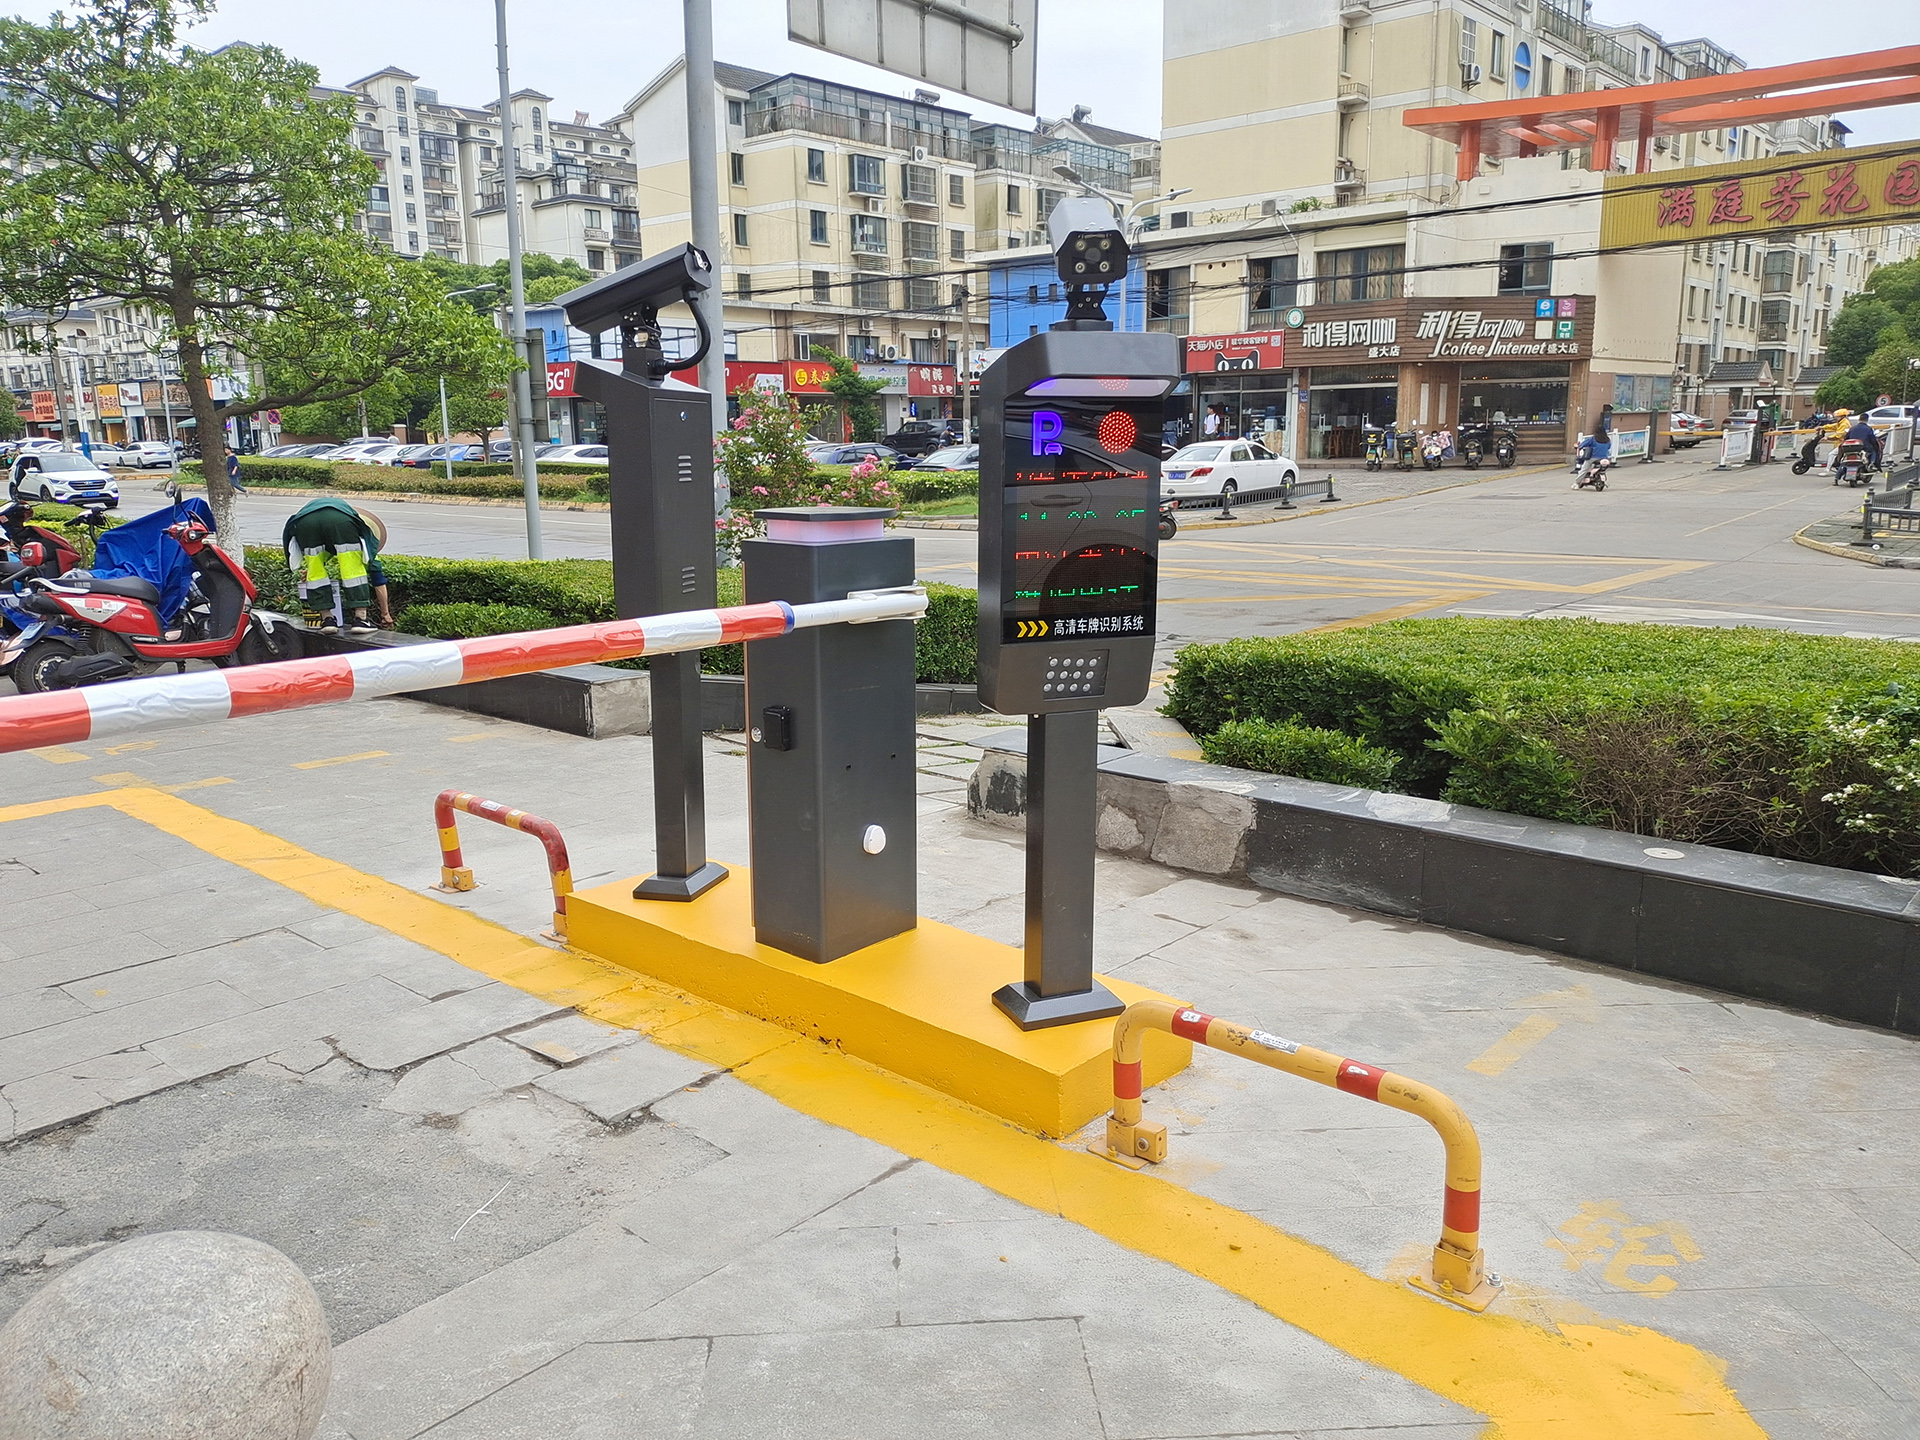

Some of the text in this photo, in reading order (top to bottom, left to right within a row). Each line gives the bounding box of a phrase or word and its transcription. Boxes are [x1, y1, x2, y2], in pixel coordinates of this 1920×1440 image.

[1657, 159, 1920, 229] 满庭芳花园
[1302, 318, 1397, 348] 利得网咖
[1415, 310, 1526, 357] 利得网咖
[1187, 339, 1225, 352] 天猫小店
[1368, 345, 1401, 358] 盛大店
[1440, 342, 1485, 356] Coffee
[1547, 342, 1579, 355] 盛大店
[1880, 397, 1887, 405] 5
[1032, 411, 1063, 456] P
[1054, 615, 1144, 637] 高清车牌识别系统
